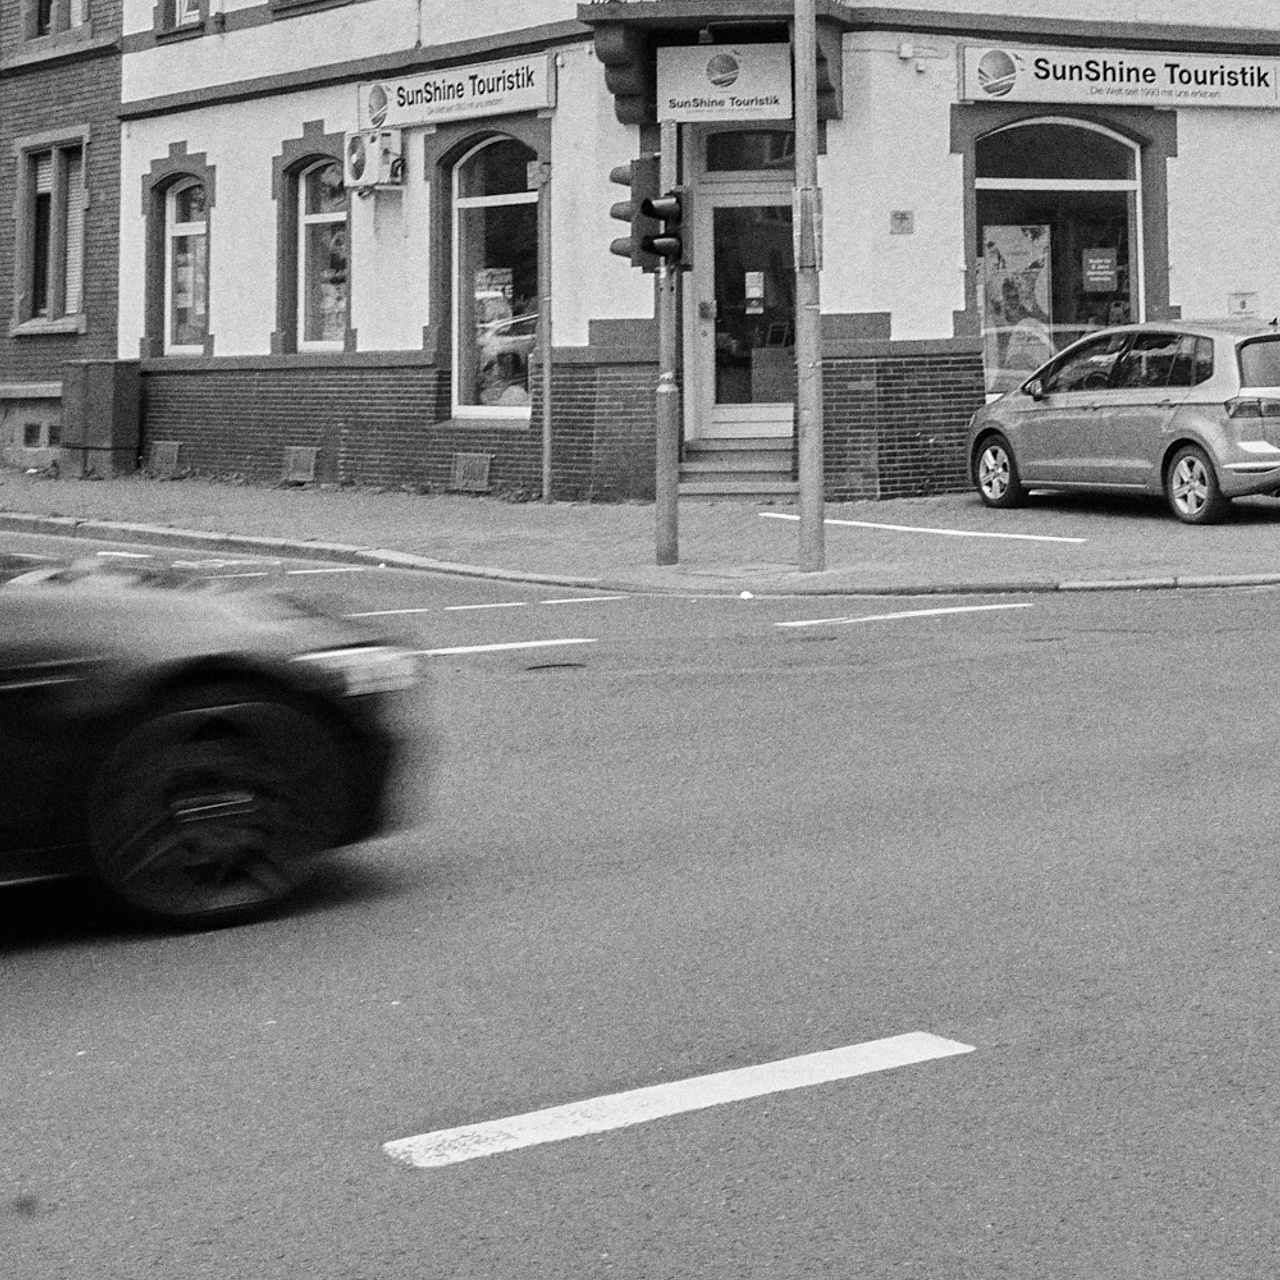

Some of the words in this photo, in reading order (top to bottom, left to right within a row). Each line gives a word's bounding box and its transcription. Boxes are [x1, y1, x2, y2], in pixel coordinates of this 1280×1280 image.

[397, 79, 465, 107] SunShine
[469, 66, 535, 96] Touristik
[1034, 58, 1157, 83] SunShine
[1164, 63, 1271, 88] Touristik
[668, 97, 726, 109] SunShine
[729, 95, 781, 107] Touristik
